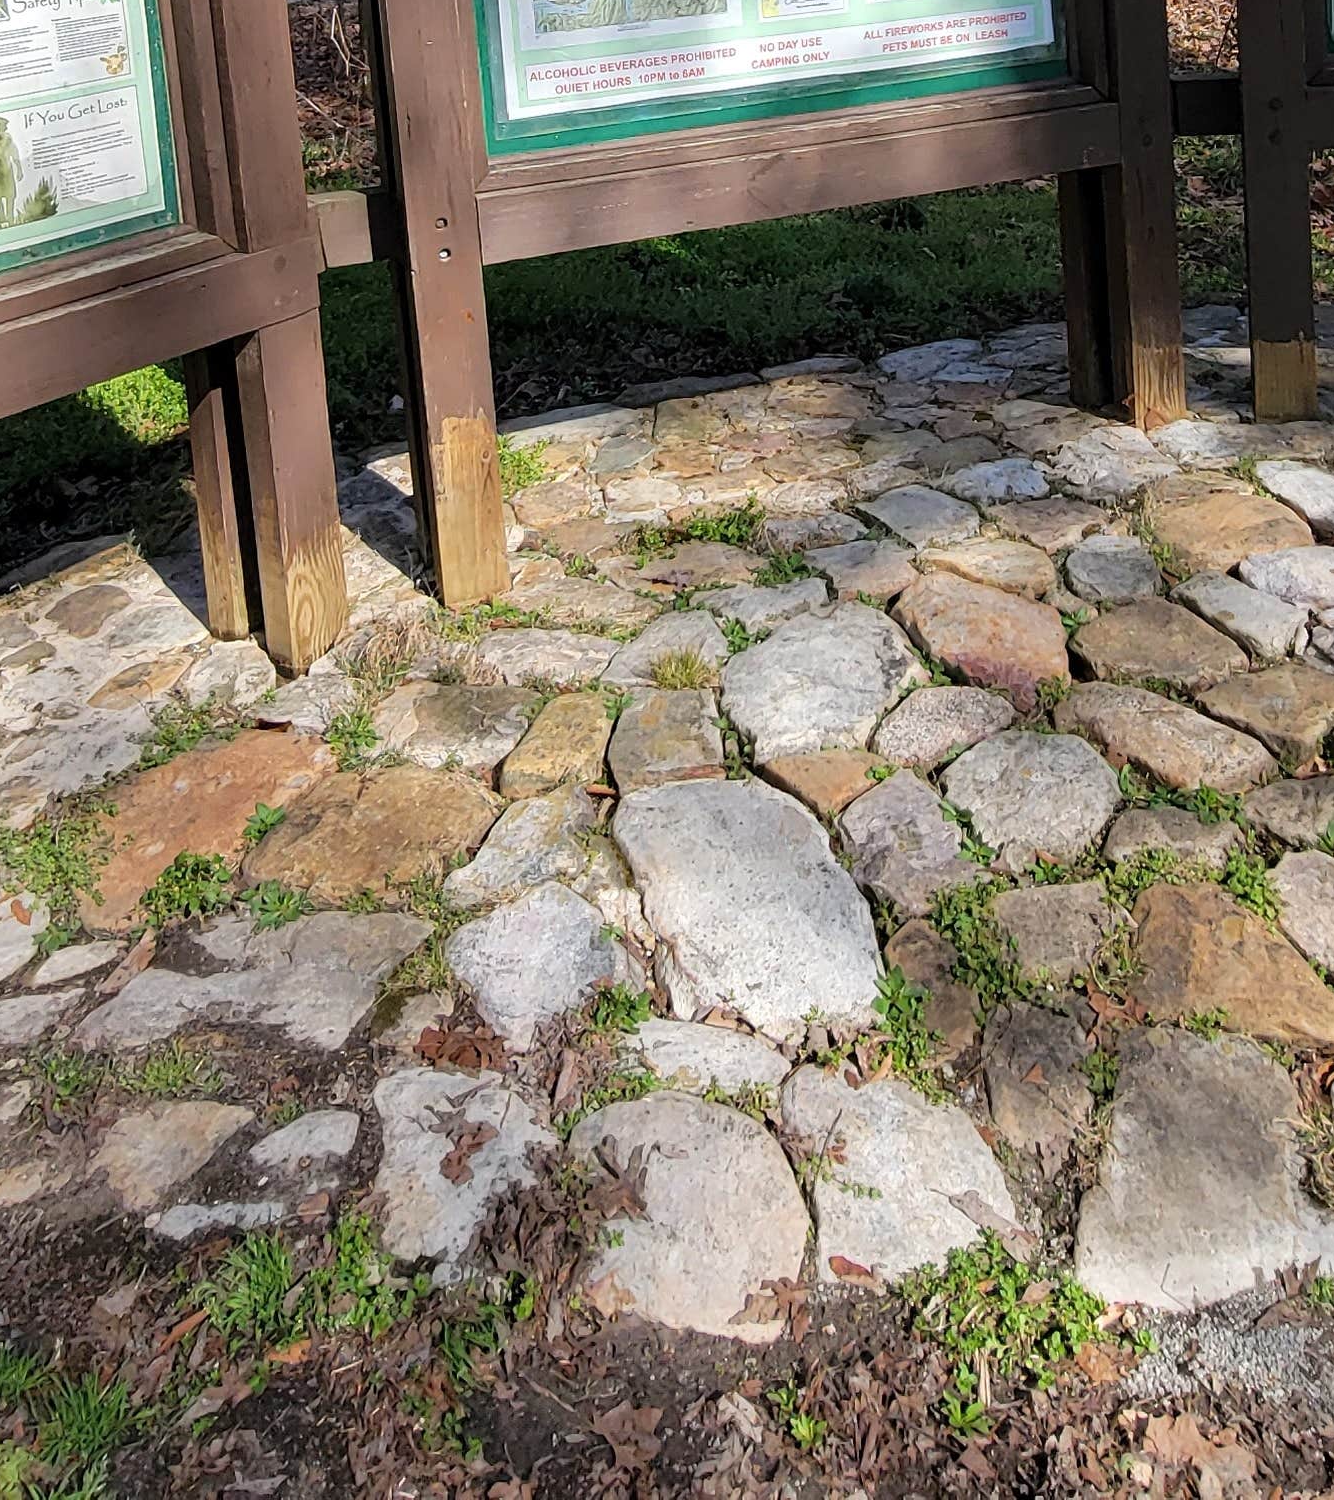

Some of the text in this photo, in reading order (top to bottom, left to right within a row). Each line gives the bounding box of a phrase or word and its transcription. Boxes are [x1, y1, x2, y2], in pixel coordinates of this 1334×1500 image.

[864, 12, 1027, 40] ALL FIREWORKS ARE PROHIBITED
[759, 37, 822, 52] NO DAY USE
[882, 29, 1008, 52] PETS MUST BE ON LEASH
[529, 47, 736, 81] ALCOHOLIC BEVERAGES PROHIBITED
[751, 51, 830, 69] CAMPING ONLY
[592, 76, 632, 90] HOURS
[638, 73, 666, 84] 10PM
[669, 71, 680, 80] to
[24, 114, 35, 129] If
[37, 110, 65, 125] You
[68, 103, 95, 119] Get
